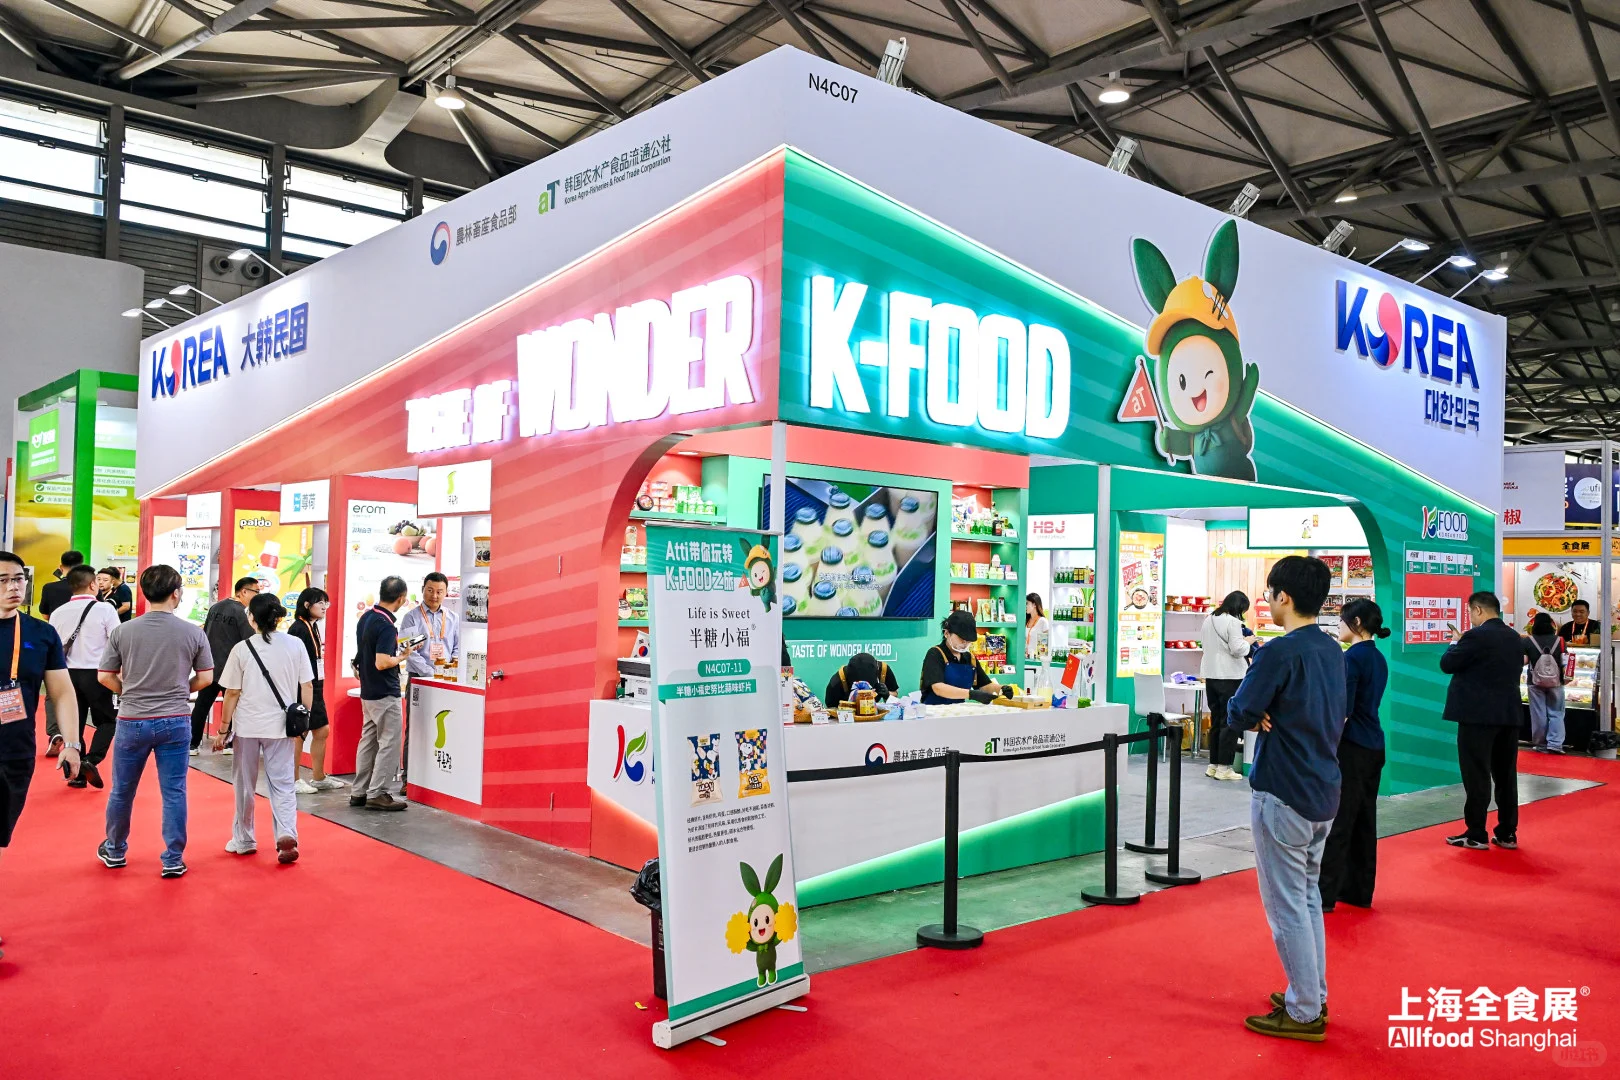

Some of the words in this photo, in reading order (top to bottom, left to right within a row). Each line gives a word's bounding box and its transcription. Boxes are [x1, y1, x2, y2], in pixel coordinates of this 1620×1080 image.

[808, 73, 858, 103] N4C07
[564, 134, 671, 194] 韩国农水产食品流通公社
[564, 194, 576, 204] Korea
[578, 181, 608, 200] Agro-Fisheries
[614, 174, 626, 184] Food
[626, 168, 640, 178] Trade
[640, 156, 670, 174] Corporation
[538, 180, 560, 214] aT
[456, 204, 517, 246] 農林畜産食品部
[240, 302, 308, 370] 大韩民国
[1335, 279, 1480, 390] KOREA
[152, 325, 229, 399] KOREA
[517, 274, 755, 438] WONDER
[810, 275, 1071, 438] K-FOOD
[1424, 388, 1480, 432] 대한민국
[352, 504, 386, 514] erom
[1504, 509, 1522, 525] 椒
[240, 516, 272, 529] paldo
[1033, 520, 1065, 534] HBJ
[666, 540, 732, 564] Atti带你玩转
[1562, 542, 1590, 550] 全食展
[665, 566, 734, 592] K-FOOD之旅
[688, 607, 706, 619] Life
[710, 607, 718, 618] is
[722, 607, 750, 619] Sweet
[689, 627, 750, 648] 半糖小福
[792, 644, 814, 658] TASTE
[818, 644, 828, 658] OF
[830, 644, 862, 657] WONDER
[864, 644, 892, 656] K-FOOD
[706, 662, 742, 674] N4C07-11
[985, 738, 1000, 754] aT
[1004, 733, 1066, 746] 韩国农水产食品流通公社
